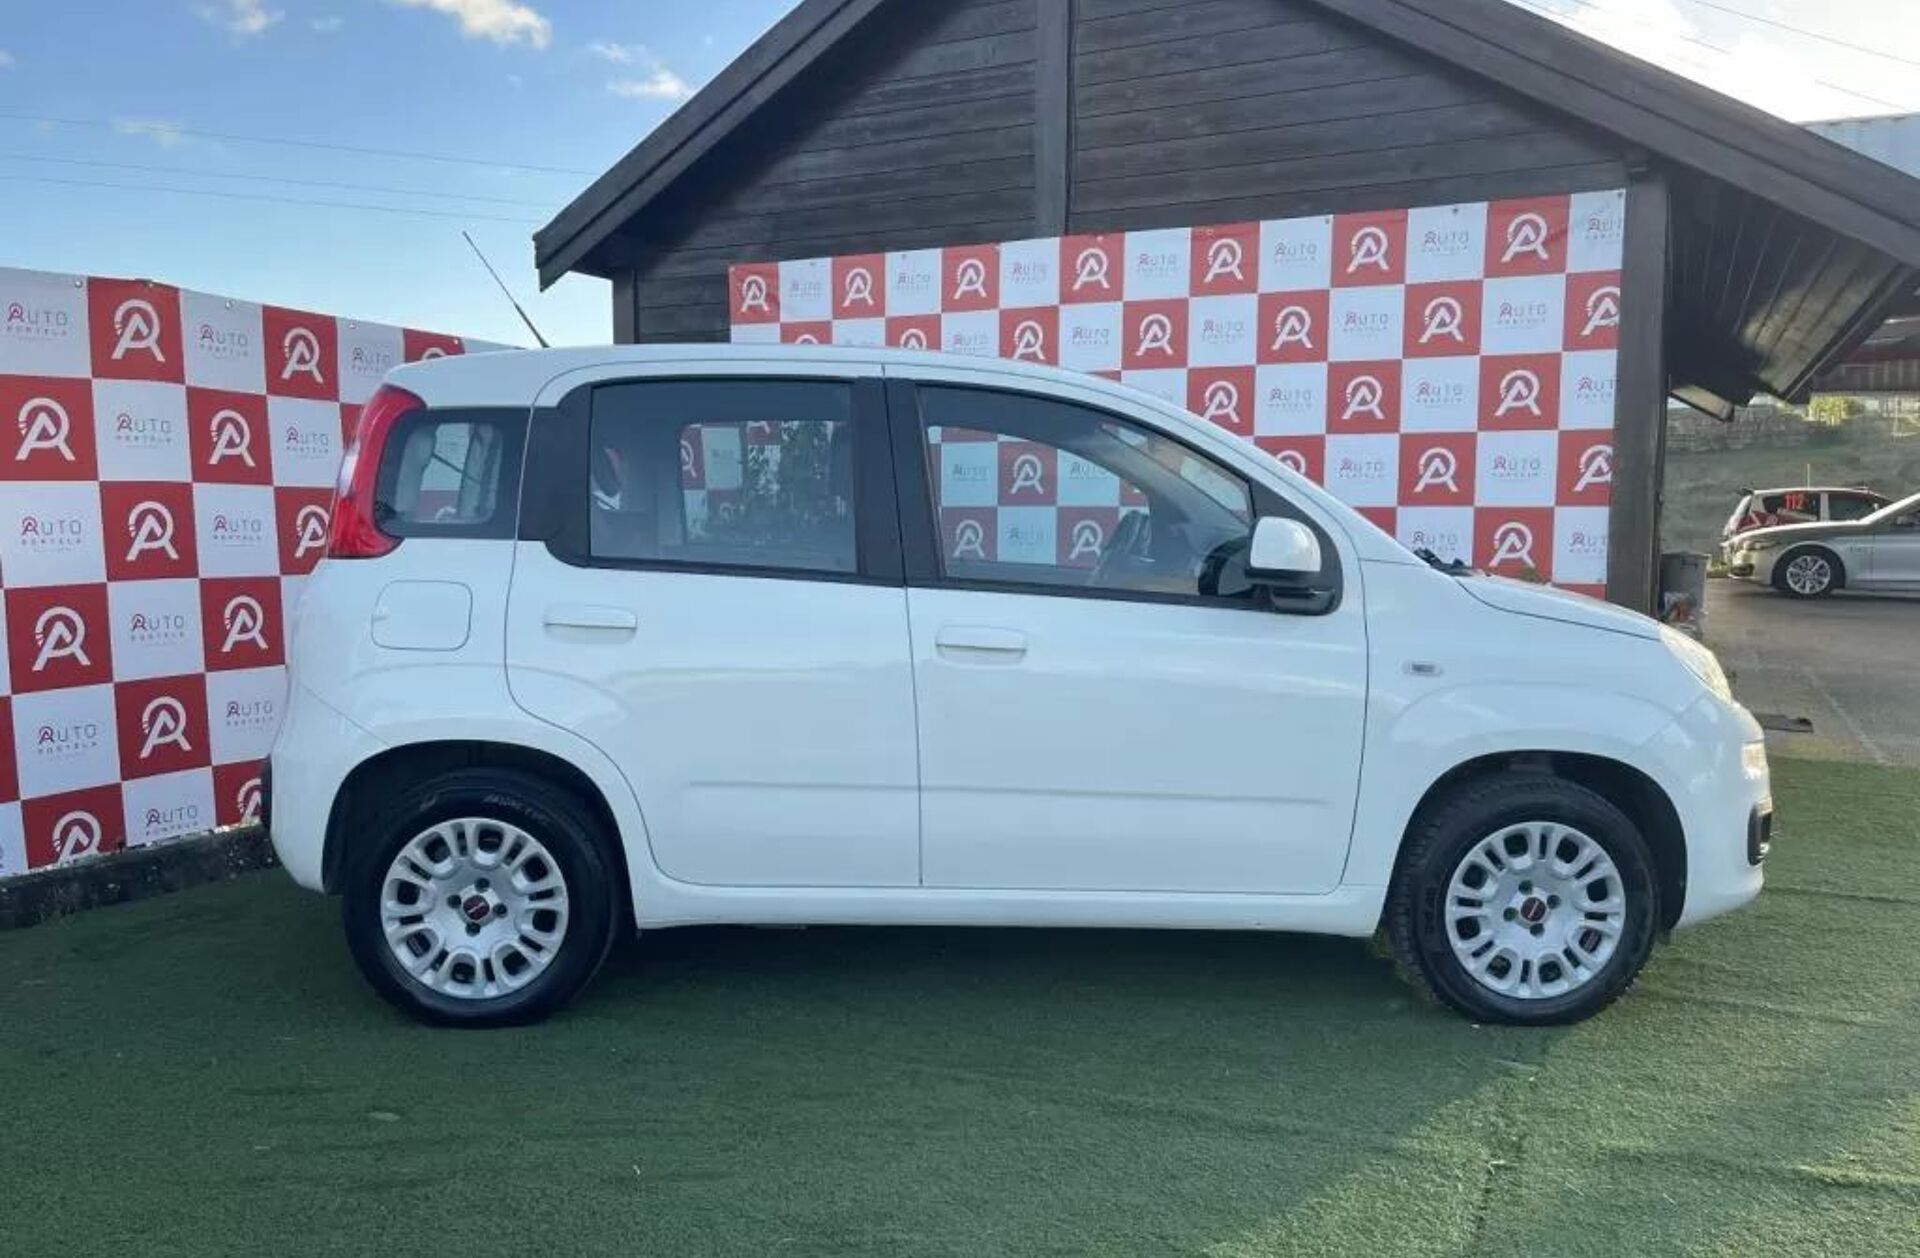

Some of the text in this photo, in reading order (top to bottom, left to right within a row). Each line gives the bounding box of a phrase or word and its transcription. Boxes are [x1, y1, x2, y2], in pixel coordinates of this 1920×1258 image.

[8, 302, 68, 326] AUTO
[200, 324, 248, 347] AUTO
[1578, 376, 1621, 392] AUT
[117, 413, 172, 434] AUTO
[287, 426, 328, 446] AUTO
[22, 516, 82, 536] AUTO
[214, 514, 261, 533] AUTO
[131, 613, 185, 632] AUTO
[227, 701, 273, 718] AUTO
[38, 724, 97, 745] AUTO
[146, 805, 198, 827] AUTO
